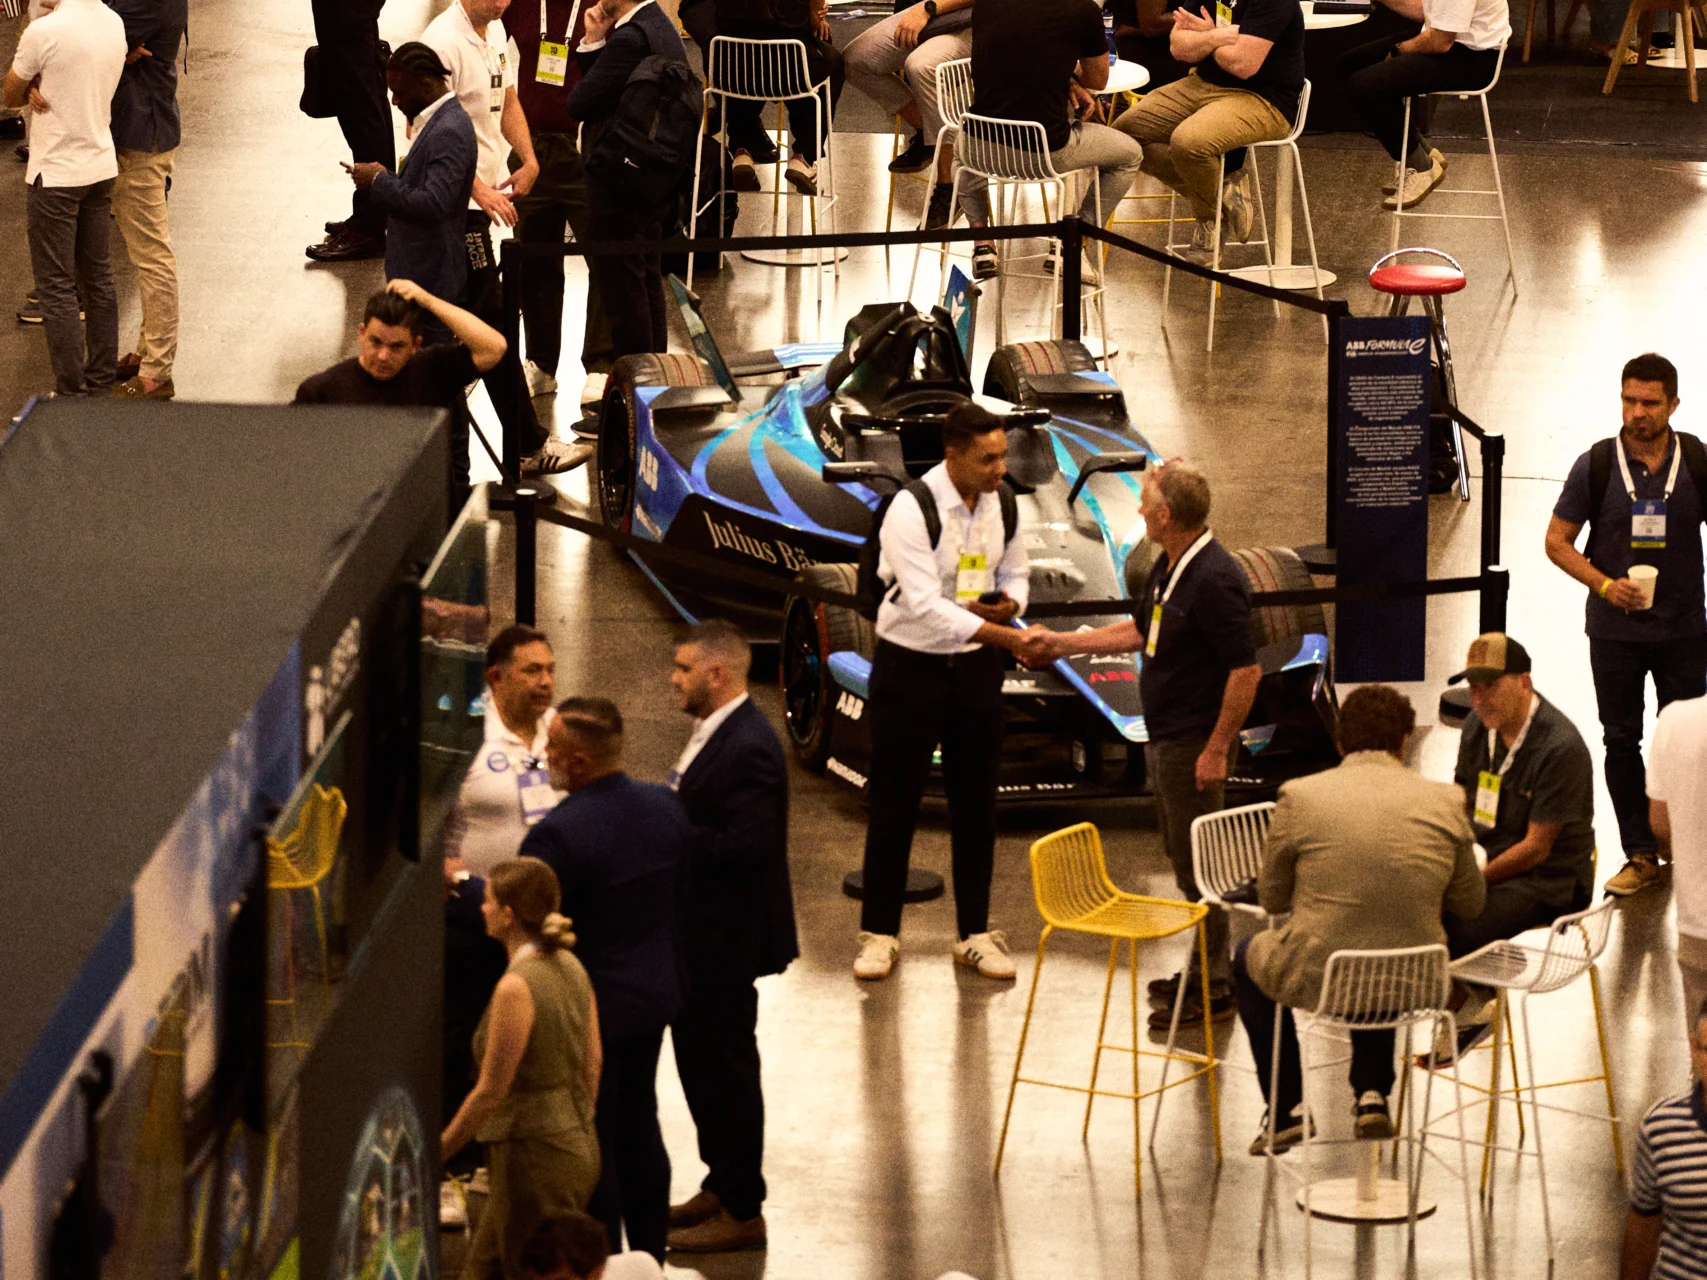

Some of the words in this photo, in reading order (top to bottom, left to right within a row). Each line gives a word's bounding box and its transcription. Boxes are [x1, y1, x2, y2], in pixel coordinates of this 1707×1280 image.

[464, 233, 482, 270] RACE
[639, 445, 658, 492] ABB
[703, 510, 777, 564] Julius
[836, 690, 864, 720] ABB
